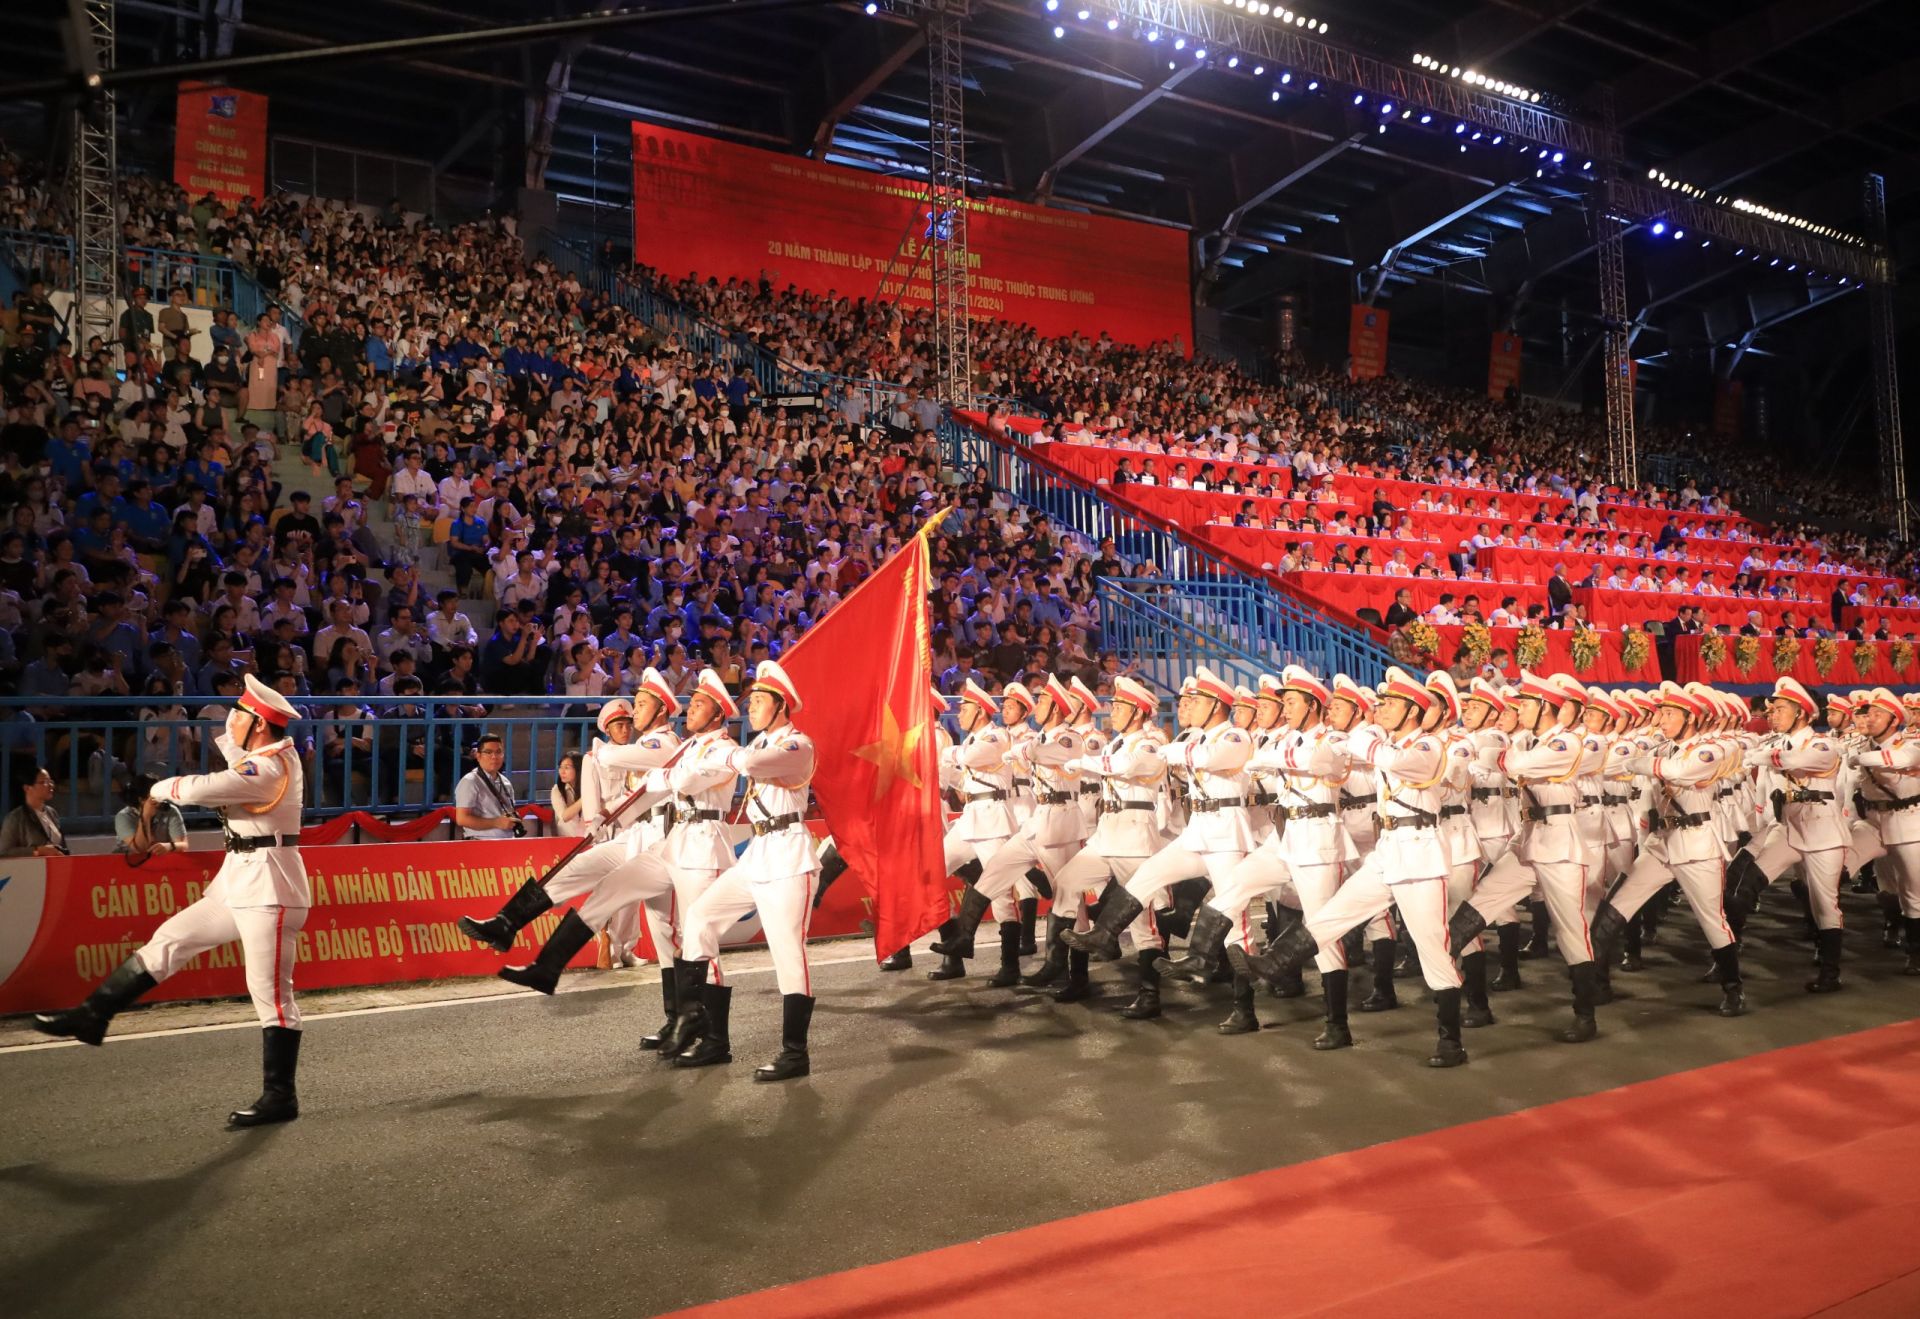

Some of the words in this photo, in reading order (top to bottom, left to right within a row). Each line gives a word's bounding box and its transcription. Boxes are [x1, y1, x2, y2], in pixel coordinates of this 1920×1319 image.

[768, 241, 782, 256] 20
[785, 243, 811, 261] NĂM
[813, 247, 850, 266] THÀNH
[852, 255, 872, 272] LẬP
[900, 238, 917, 258] LỄ
[979, 276, 1003, 294] TRỰC
[1005, 280, 1036, 299] THUỘC
[1037, 285, 1068, 302] TRUNG
[91, 878, 140, 918] CÁN
[333, 866, 388, 905] NHÂN
[392, 865, 434, 902] DÂN
[436, 862, 500, 900] THÀNH
[315, 918, 373, 962] ĐẢNG
[375, 919, 403, 962] BỘ
[406, 922, 472, 955] TRONG
